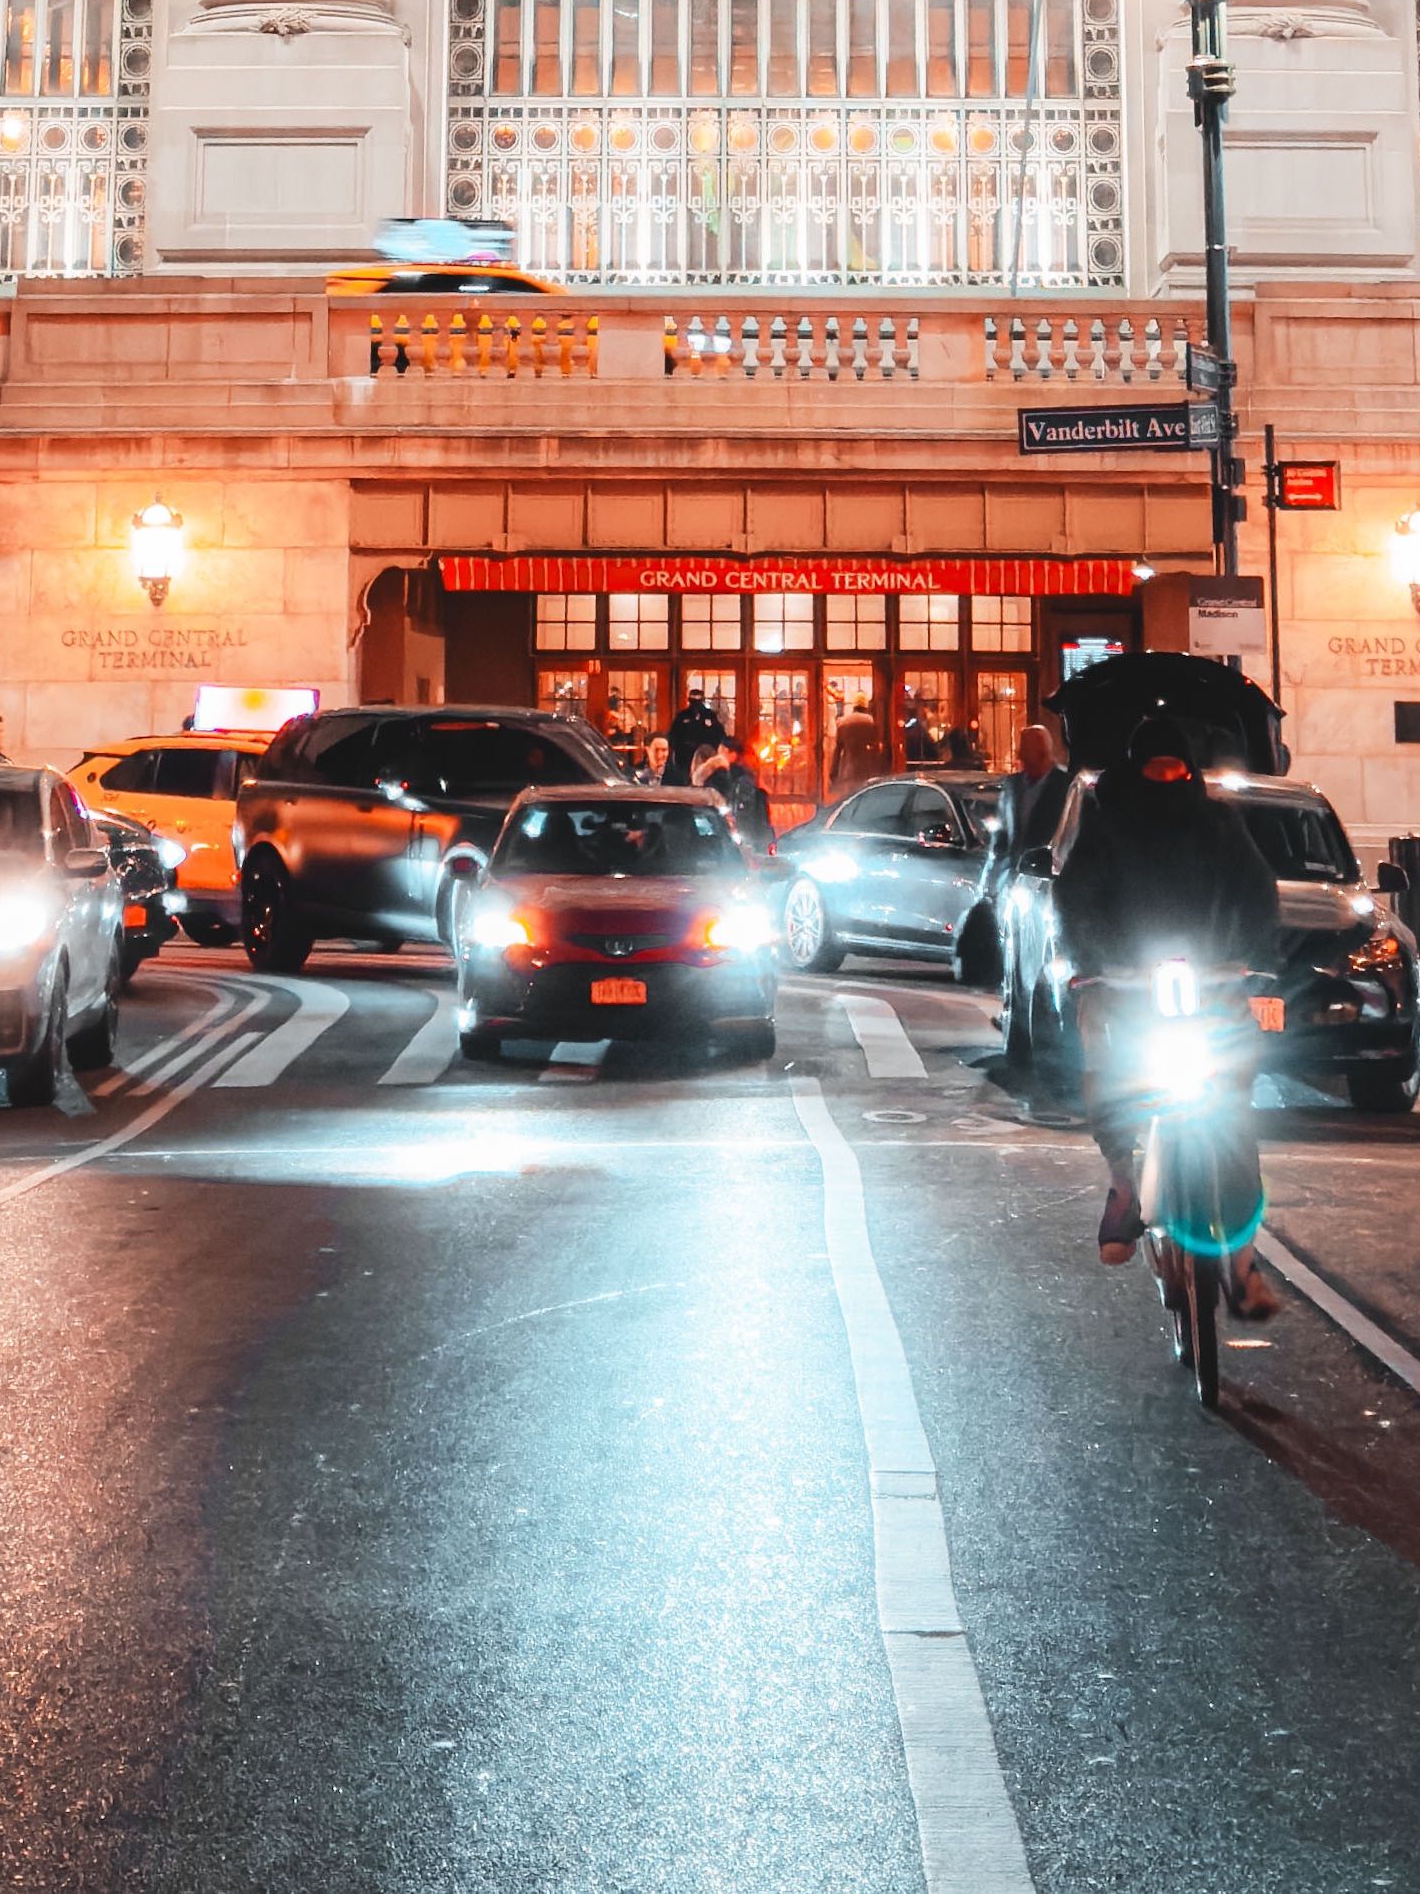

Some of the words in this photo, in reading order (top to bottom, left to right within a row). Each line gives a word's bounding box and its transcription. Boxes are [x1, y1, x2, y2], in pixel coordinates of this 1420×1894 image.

[1028, 419, 1140, 442] Vanderbilt
[1146, 417, 1185, 438] Ave
[639, 570, 718, 588] GRAND
[725, 571, 823, 589] CENTRAL
[831, 571, 942, 590] TERMINAL
[1198, 610, 1239, 619] Madison
[61, 630, 138, 648] GRAND
[147, 630, 248, 647] CENTRAL
[1329, 638, 1406, 656] GRAND
[98, 651, 212, 669] TERMINAL
